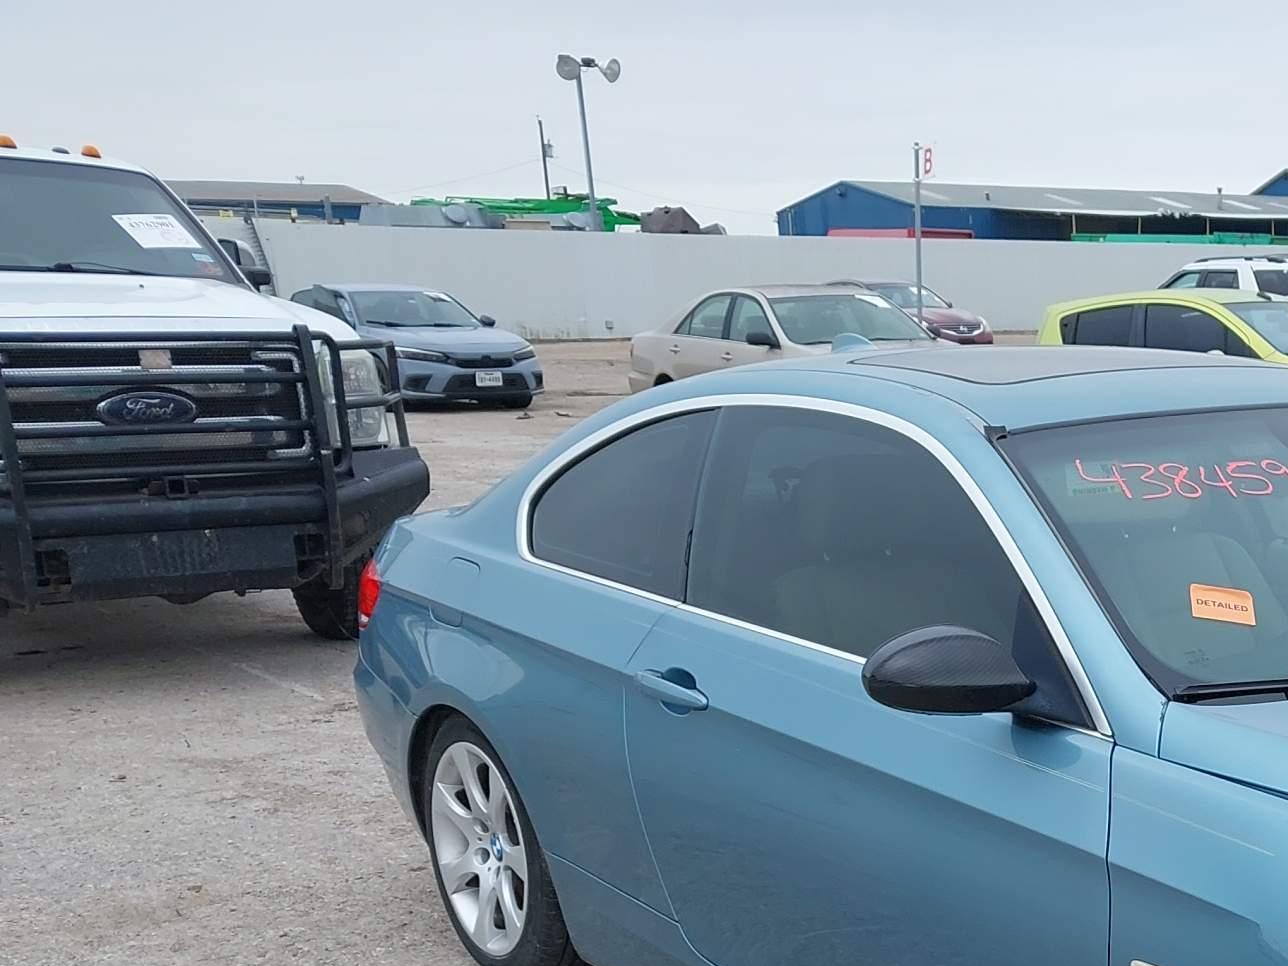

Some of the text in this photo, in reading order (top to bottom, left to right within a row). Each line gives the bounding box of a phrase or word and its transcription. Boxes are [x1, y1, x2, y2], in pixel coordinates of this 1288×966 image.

[923, 148, 933, 175] B
[123, 398, 175, 420] Ford
[1196, 598, 1249, 612] DETAILED
